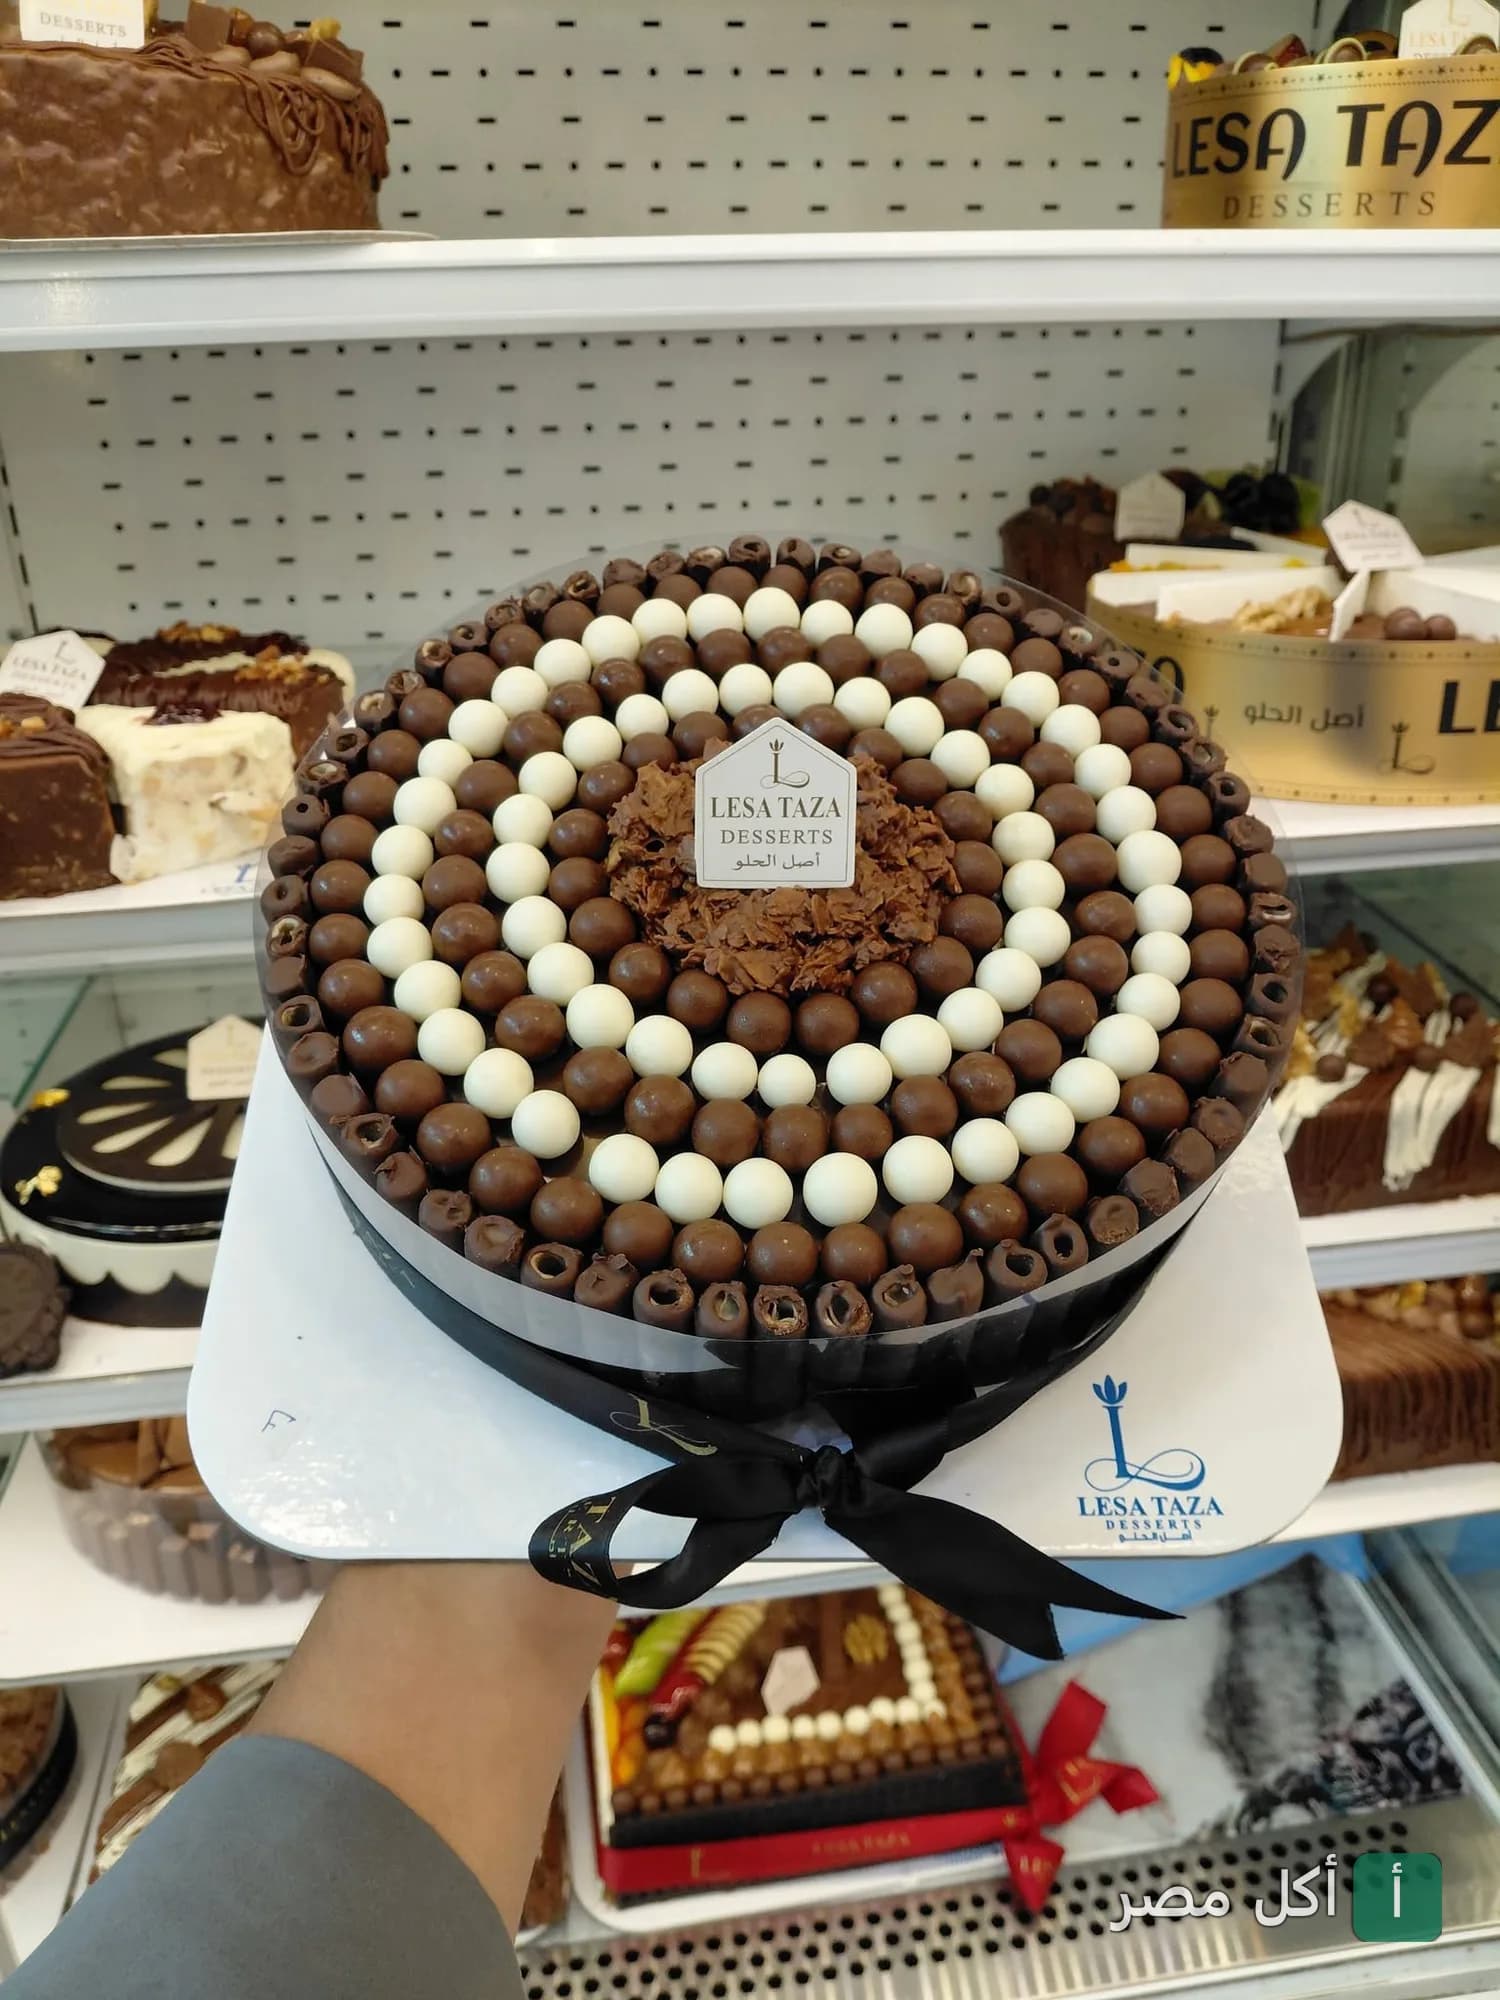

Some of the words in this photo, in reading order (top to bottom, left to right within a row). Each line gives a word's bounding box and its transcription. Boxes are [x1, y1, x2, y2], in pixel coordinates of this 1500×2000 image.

[40, 11, 127, 38] DESSERTS
[1173, 107, 1306, 181] LESA
[1224, 190, 1436, 219] DESSERTS
[1244, 702, 1302, 724] الحلو
[711, 797, 772, 818] LESA
[777, 797, 841, 818] TAZA
[720, 829, 833, 845] DESSERTS
[732, 854, 776, 871] الحلو
[782, 852, 820, 870] أصل
[1077, 1496, 1147, 1516] LESA
[1150, 1496, 1224, 1516] TAZA
[1105, 1518, 1202, 1530] DESSERTS
